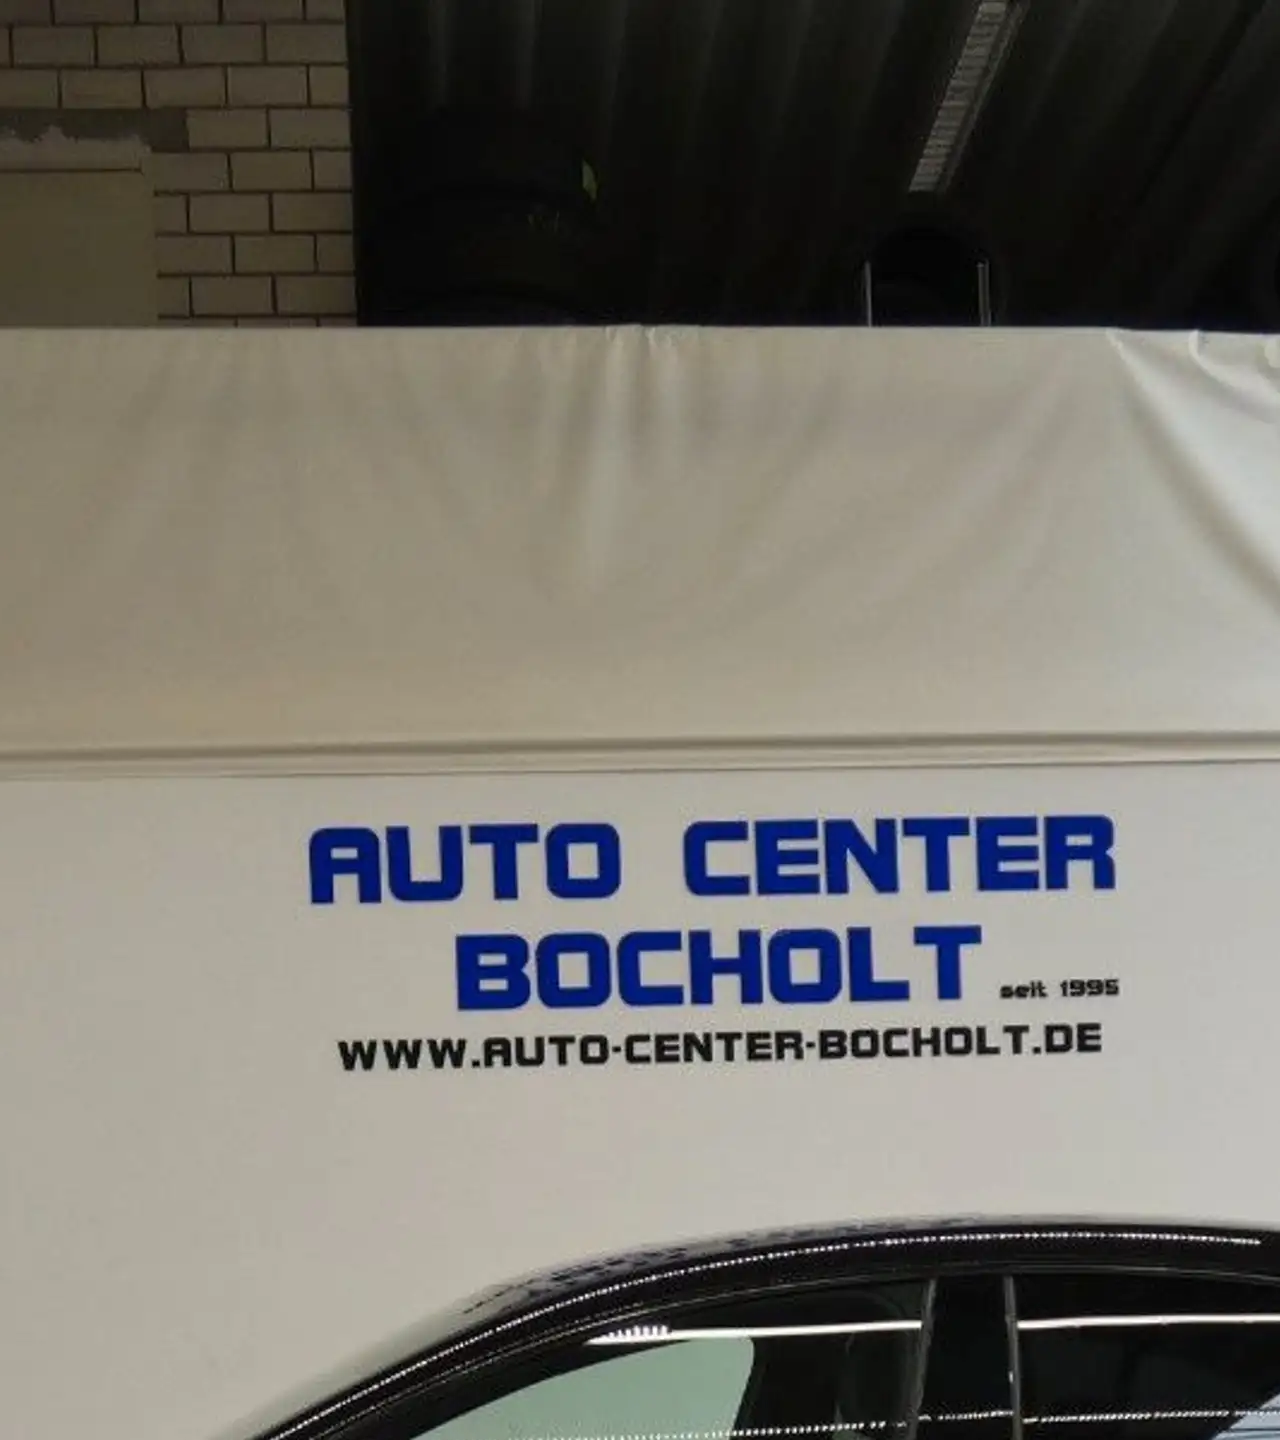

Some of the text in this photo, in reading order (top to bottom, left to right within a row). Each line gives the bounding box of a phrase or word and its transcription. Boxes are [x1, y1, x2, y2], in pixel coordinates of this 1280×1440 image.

[309, 814, 1117, 904] AUTO CENTER
[455, 924, 1120, 1011] BOCHOLT seit 1995
[337, 1022, 1103, 1072] WWW.AUTO-CENTER-BOCHOLT.DE
